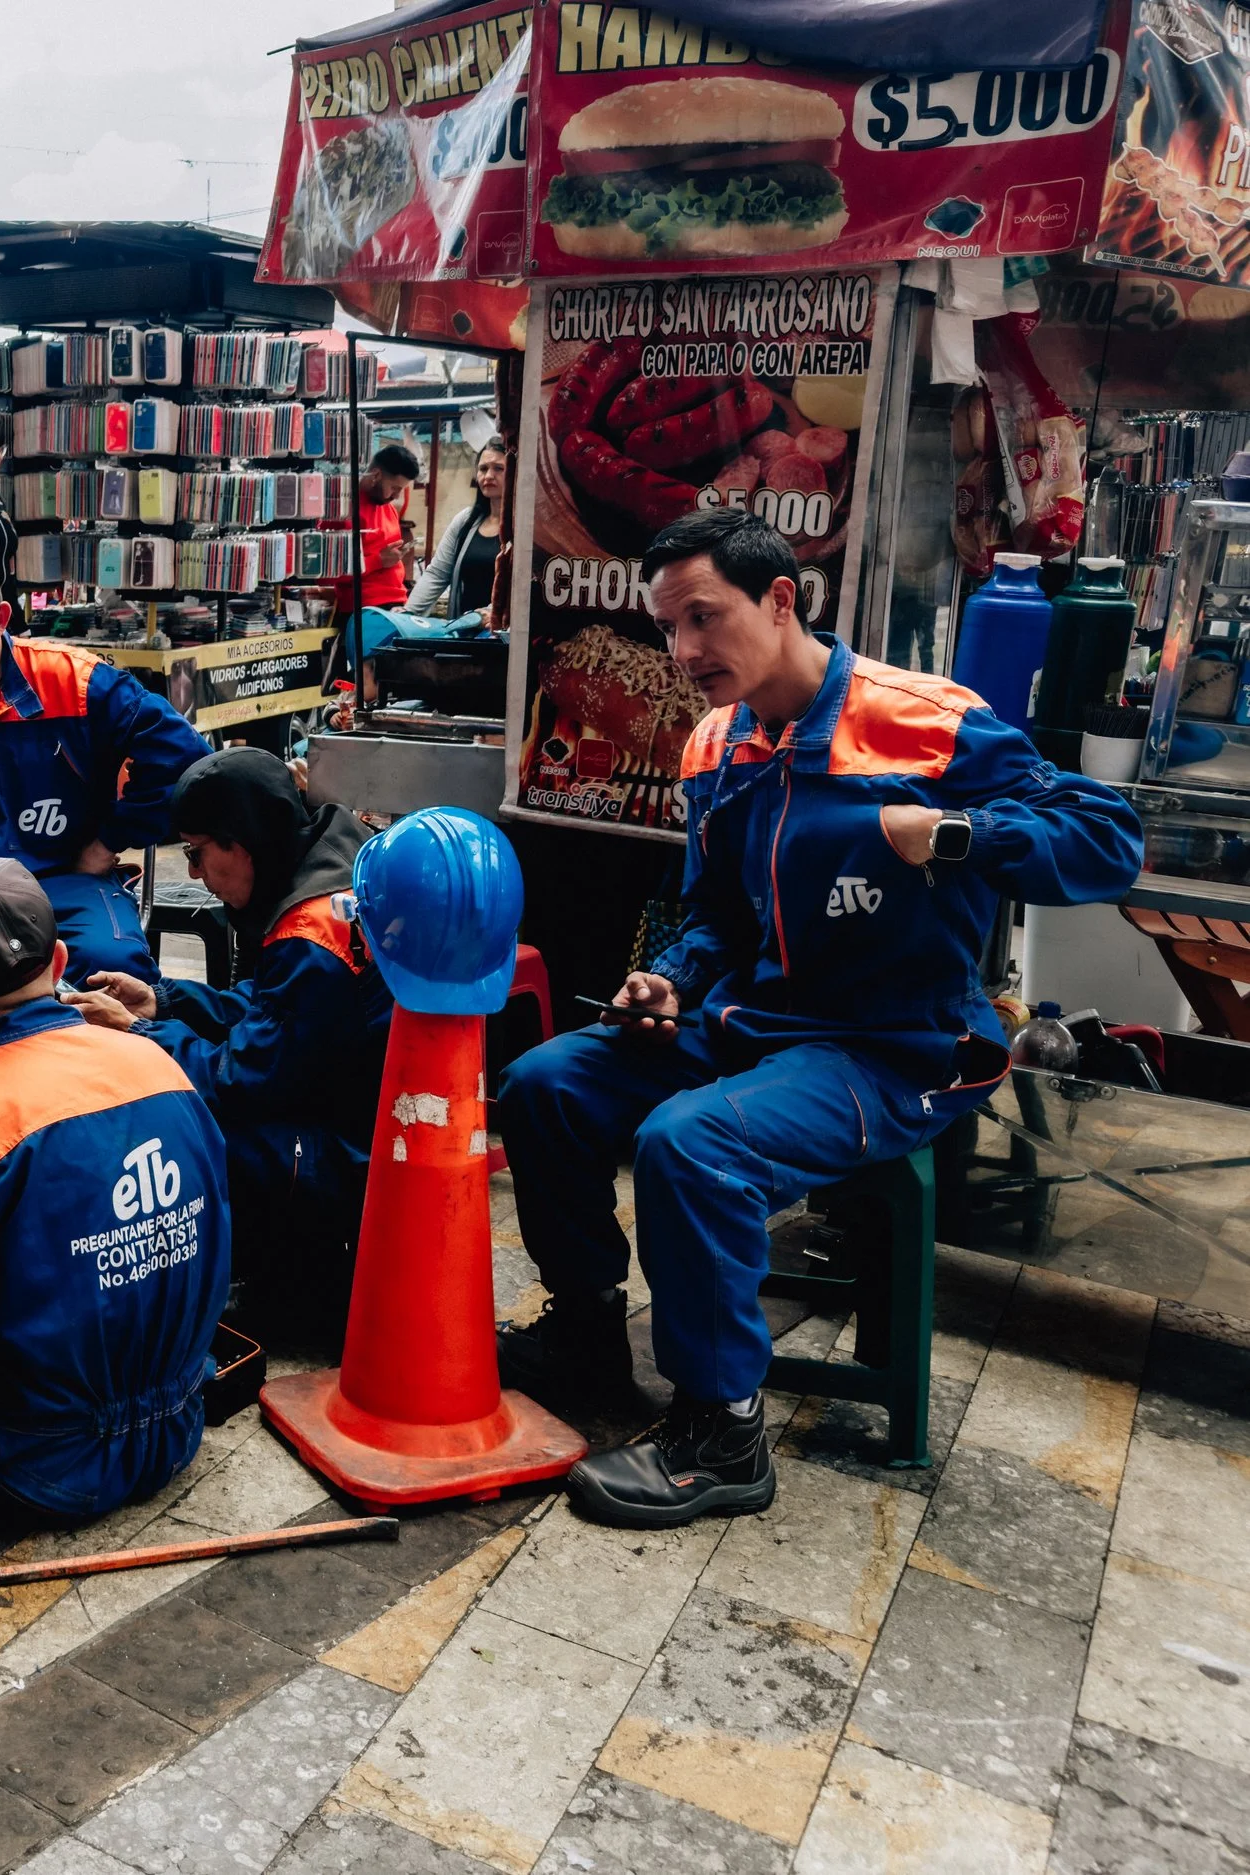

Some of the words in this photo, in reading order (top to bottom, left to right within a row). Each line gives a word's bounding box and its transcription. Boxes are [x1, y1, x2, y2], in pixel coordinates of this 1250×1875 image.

[558, 2, 791, 74] HAMB
[298, 51, 390, 123] PERRO
[389, 9, 533, 107] CALIENT
[867, 53, 1109, 151] $5.000
[917, 245, 981, 258] NEQUI
[550, 281, 656, 342] CHORIZO
[658, 276, 871, 339] SANTARROSANO
[643, 345, 682, 378] CON
[684, 344, 729, 378] PAPA
[730, 343, 747, 376] O
[750, 343, 795, 377] CON
[797, 341, 866, 376] AREPA
[694, 484, 834, 538] $5000
[541, 555, 654, 617] CHOR
[210, 666, 246, 684] VIDRIOS
[251, 655, 308, 677] CARGADORES
[227, 646, 241, 659] MIA
[243, 637, 294, 656] ACCESORIOS
[235, 677, 284, 698] AUDIFONOS
[539, 765, 570, 776] NEQUI
[18, 798, 68, 836] eTb
[527, 785, 624, 818] transfiya
[826, 876, 883, 917] eTb
[112, 1137, 181, 1221] eTb
[71, 1218, 155, 1256] PREGUNTAME
[155, 1210, 178, 1231] POR
[177, 1205, 189, 1223] LA
[188, 1196, 205, 1218] FIBRA
[96, 1218, 198, 1272] CONTRATISTA
